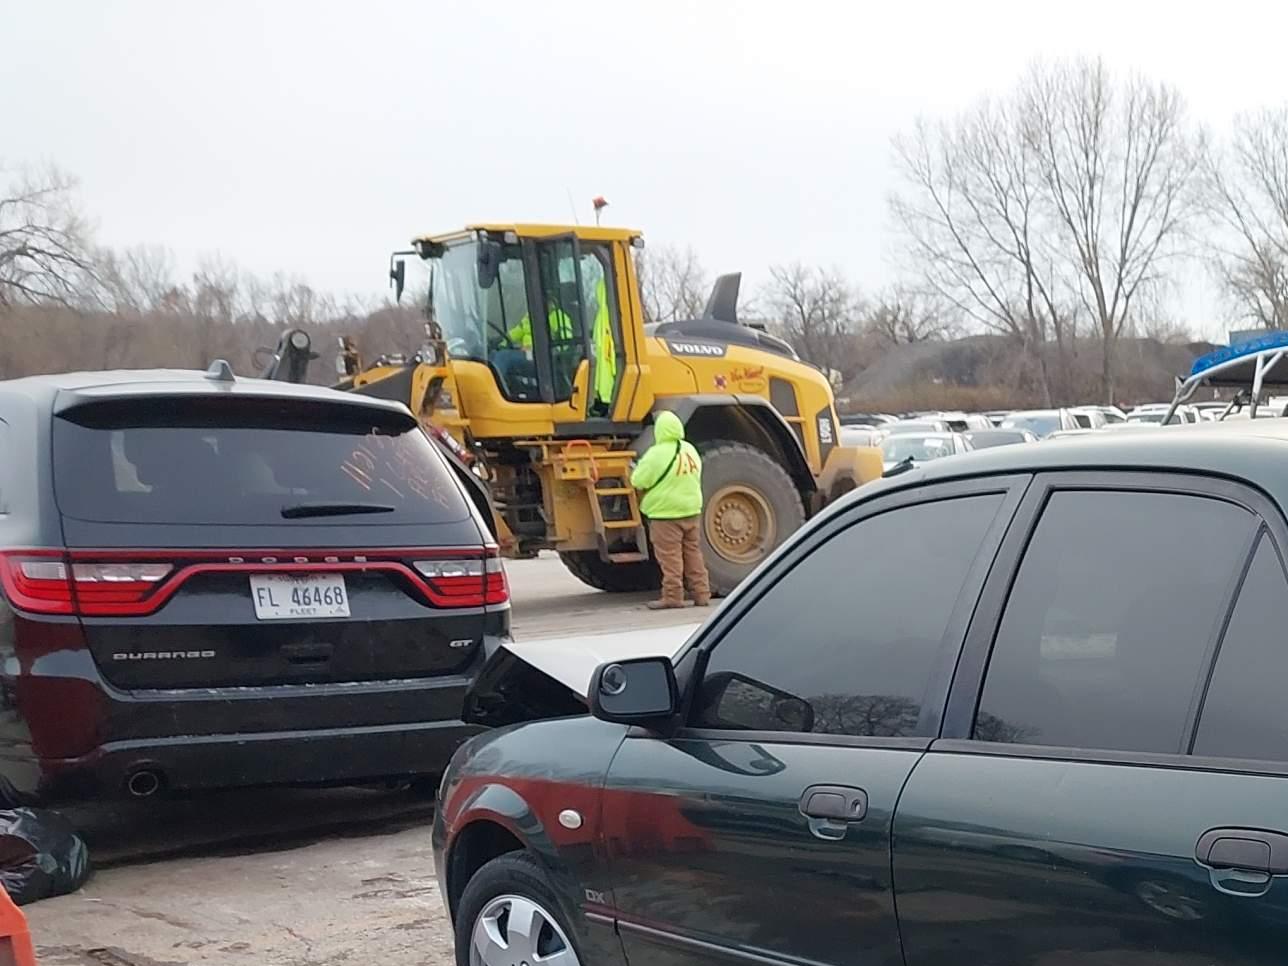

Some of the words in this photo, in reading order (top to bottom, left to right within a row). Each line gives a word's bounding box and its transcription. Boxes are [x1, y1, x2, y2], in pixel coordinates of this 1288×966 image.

[671, 343, 724, 355] VOLVO
[256, 587, 280, 607] FL
[291, 586, 344, 606] 46468
[450, 639, 473, 647] GT
[113, 651, 216, 660] DURANGO
